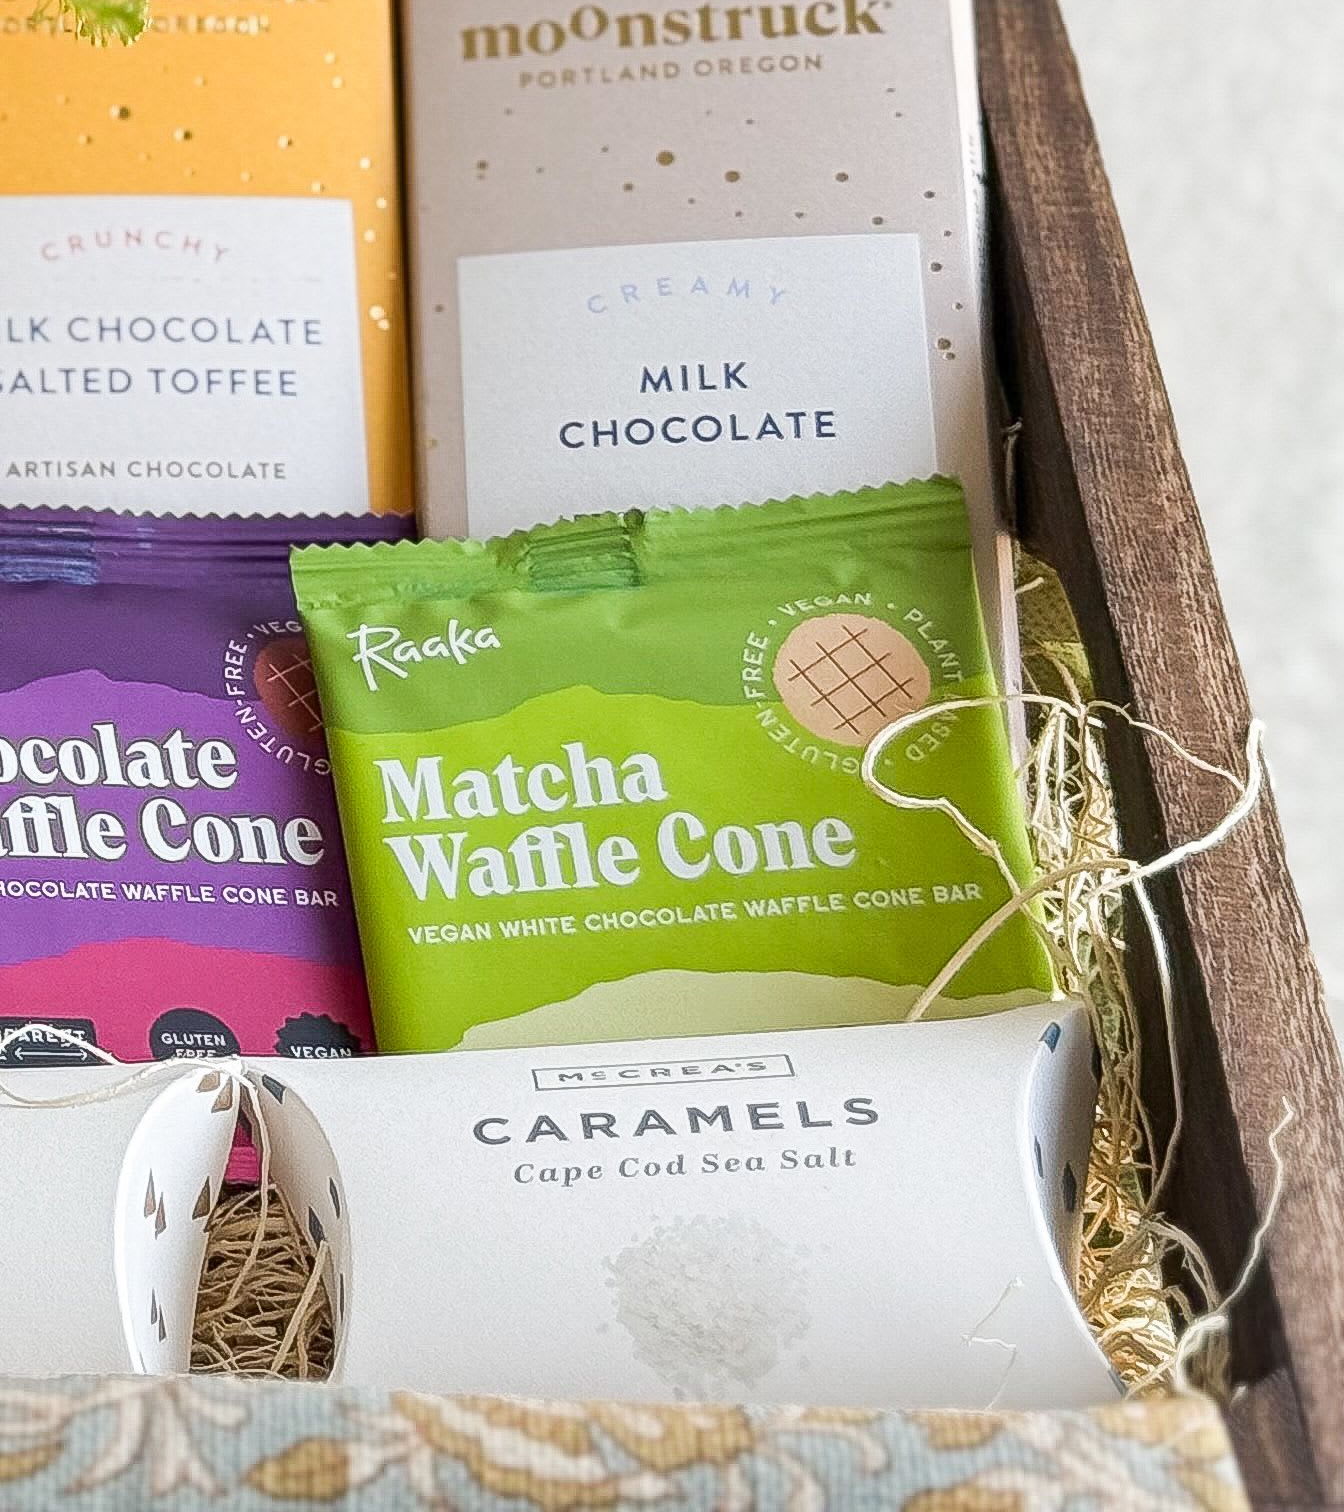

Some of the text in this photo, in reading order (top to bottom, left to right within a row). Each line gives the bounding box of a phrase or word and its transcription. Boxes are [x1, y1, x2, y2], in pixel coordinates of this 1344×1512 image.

[519, 54, 824, 89] PORTLAND OREGON
[41, 229, 230, 263] CRUNCHY
[587, 276, 785, 314] CREAMY
[67, 317, 323, 345] CHOCOLATE
[148, 368, 298, 397] TOFFEE
[640, 361, 748, 393] MILK
[559, 411, 837, 449] CHOCOLATE
[6, 461, 287, 480] ARTISAN CHOCOLATE
[777, 591, 872, 617] VEGAN
[346, 619, 501, 691] Raaka
[372, 740, 668, 824] Matcha
[141, 796, 326, 866] Cone
[383, 811, 857, 902] Waffle Cone
[121, 882, 215, 903] WAFFLE
[223, 885, 288, 905] CONE
[295, 888, 340, 907] BAR
[407, 883, 983, 945] VEGAN WHITE CHOCOLATE WAFFLE CONE BAR
[161, 1032, 227, 1047] GLUTEN
[289, 1045, 352, 1059] VEGAN
[473, 1096, 880, 1145] CARAMELS
[514, 1145, 856, 1188] Cape Cod Sea Salt
